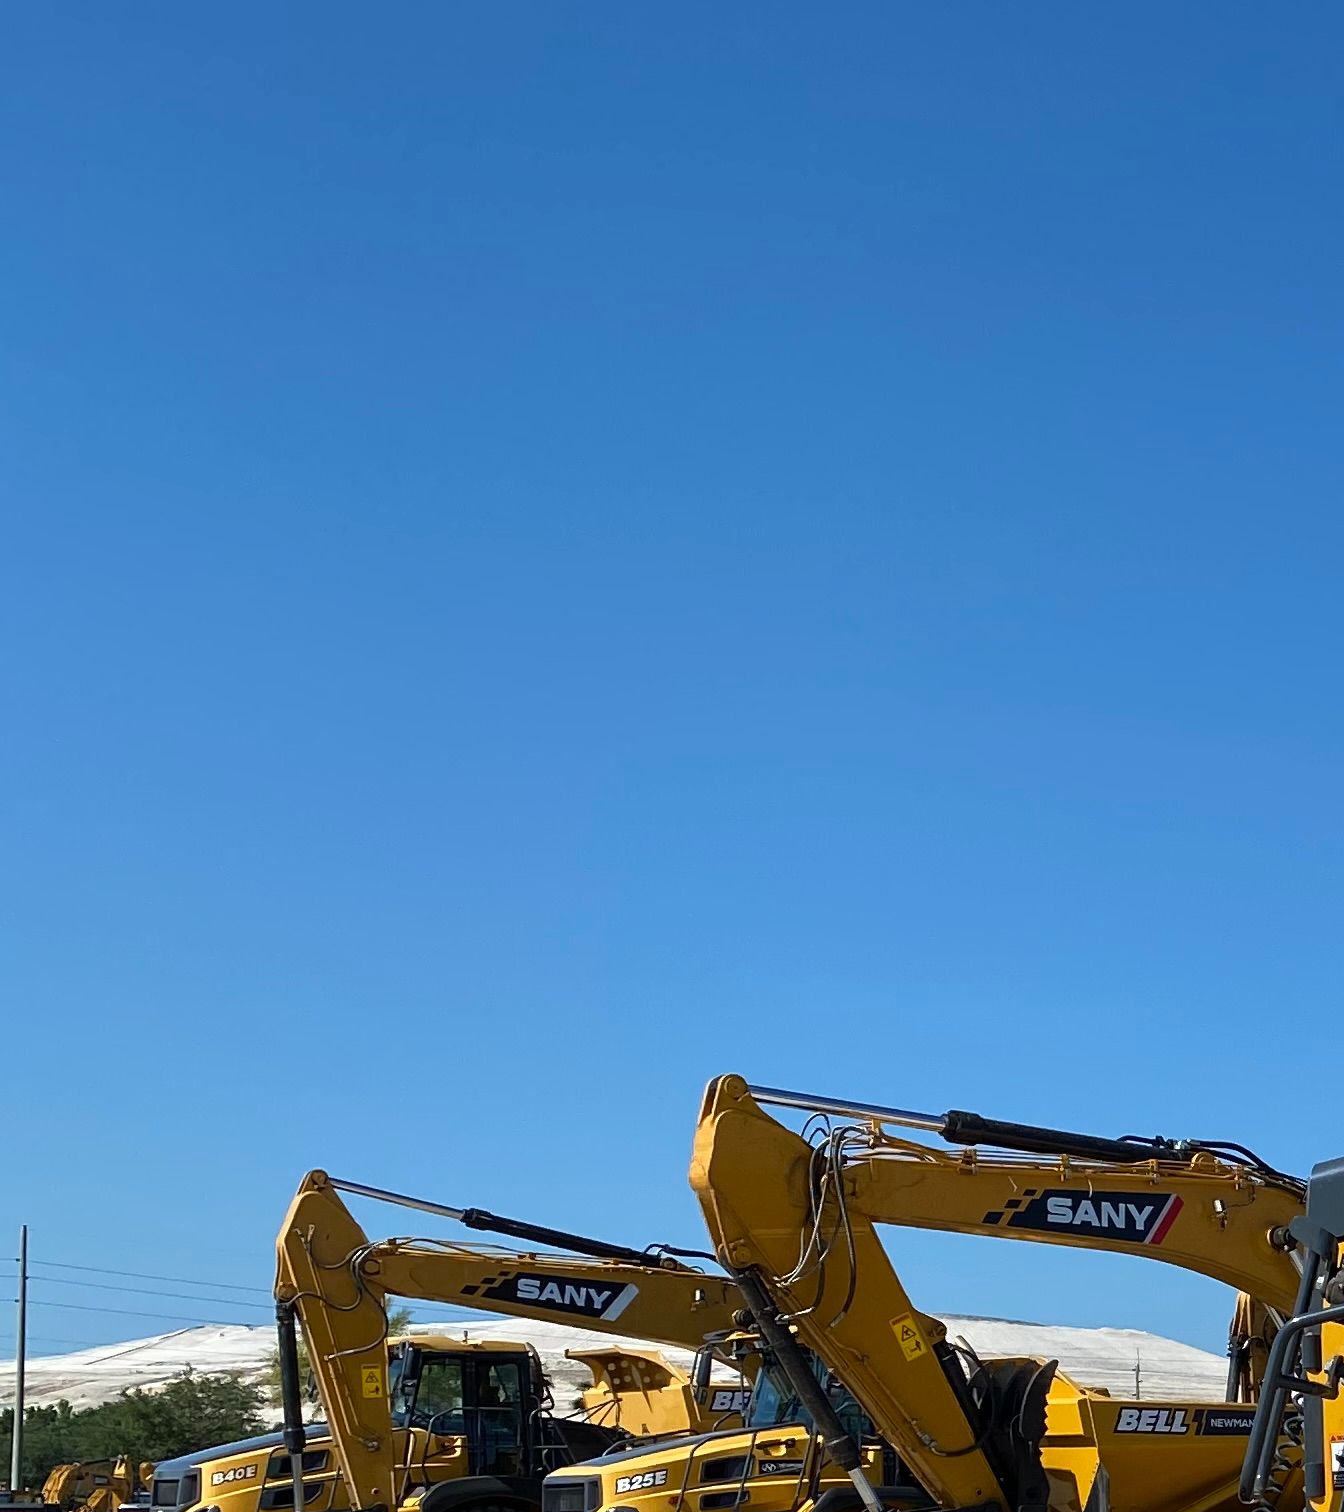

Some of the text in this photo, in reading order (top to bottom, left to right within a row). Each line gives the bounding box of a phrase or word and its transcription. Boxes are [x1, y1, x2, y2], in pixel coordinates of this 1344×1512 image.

[1046, 1197, 1155, 1231] SANY
[516, 1278, 612, 1310] SANY
[711, 1391, 752, 1411] BE
[1116, 1408, 1188, 1433] BELL
[211, 1464, 258, 1486] B40E
[616, 1469, 667, 1494] B25E
